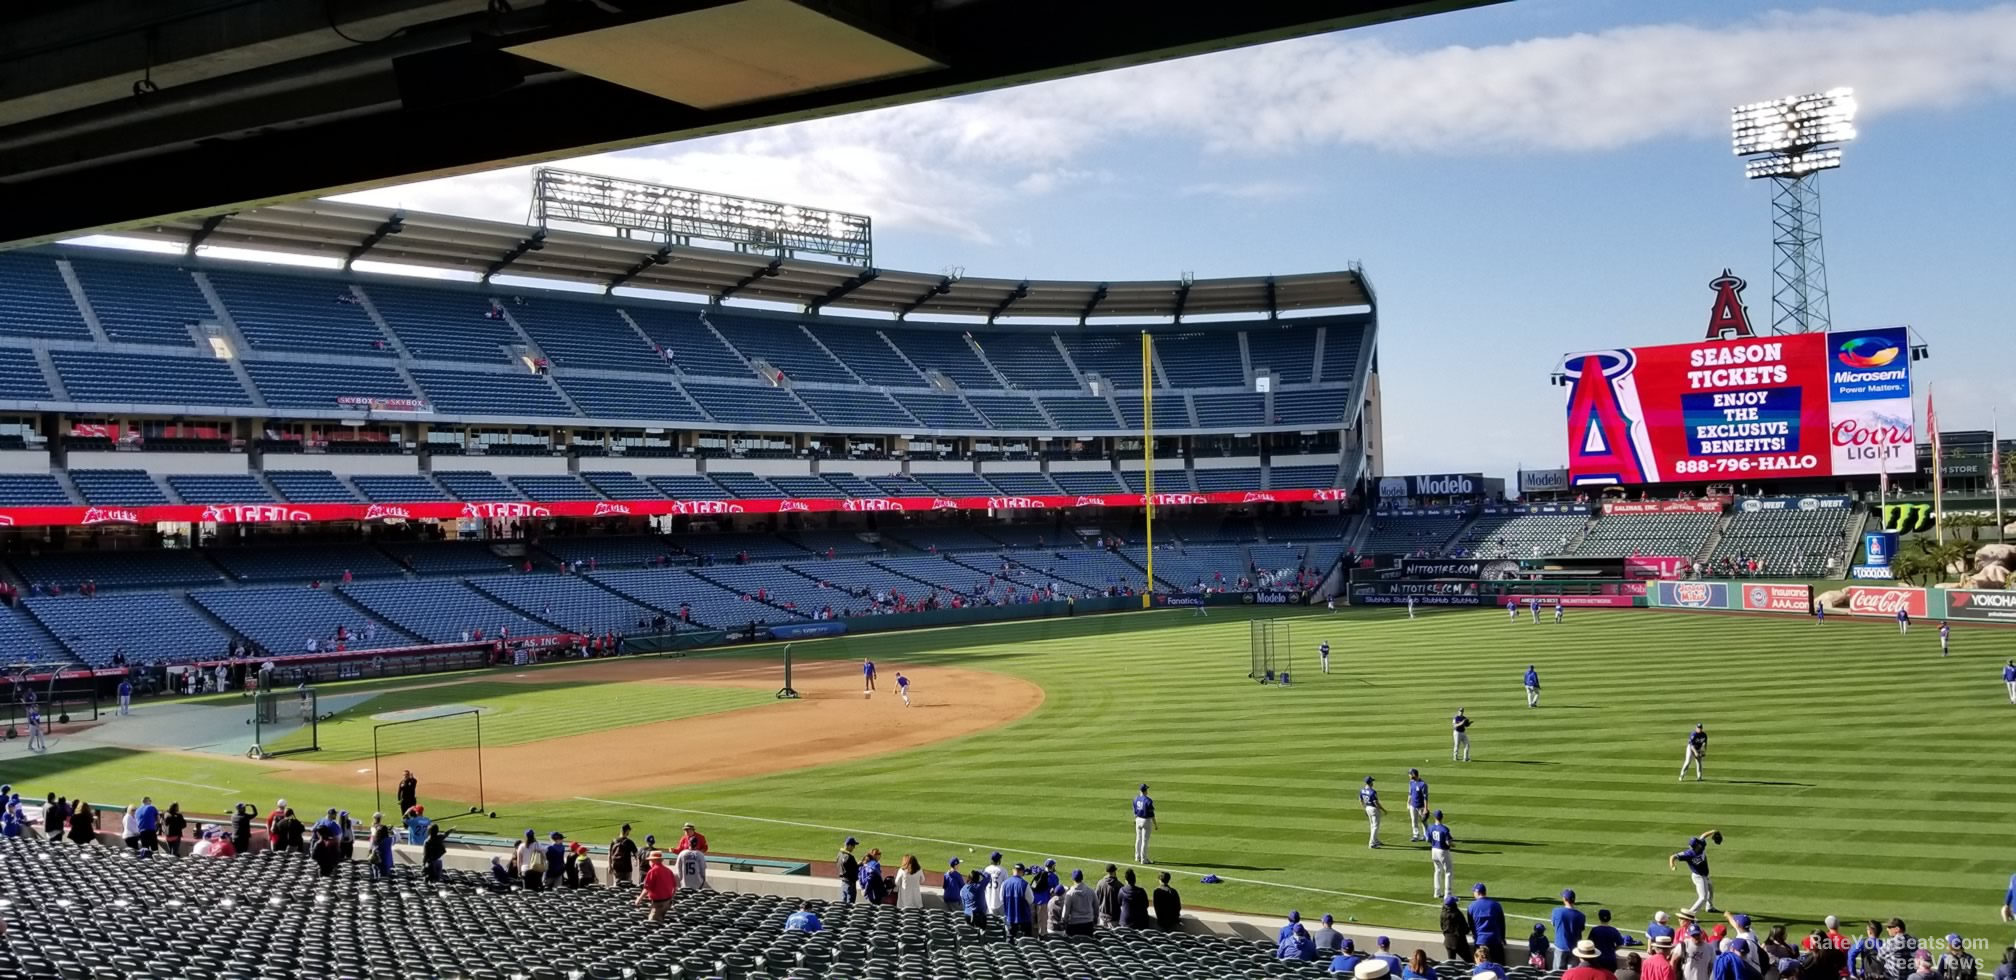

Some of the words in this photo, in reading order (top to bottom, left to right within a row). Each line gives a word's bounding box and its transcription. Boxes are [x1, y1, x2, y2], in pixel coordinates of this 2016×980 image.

[1690, 343, 1782, 368] SEASON
[1687, 365, 1788, 389] TICKETS
[1833, 368, 1906, 384] Microsemi
[1839, 386, 1866, 394] Power
[1713, 391, 1768, 407] ENJOY
[1723, 407, 1759, 421] THE
[1697, 421, 1789, 439] EXCLUSIVE
[1832, 419, 1913, 447] Coors
[1700, 437, 1786, 454] BENEFITS!
[1847, 445, 1902, 460] LIGHT
[1675, 455, 1817, 473] 888-796-HALO
[1949, 465, 1978, 473] STORE
[1416, 475, 1472, 494] Modelo
[1527, 473, 1562, 486] Modelo
[1763, 501, 1785, 509] WEST
[1821, 499, 1844, 508] WEST
[1407, 564, 1478, 575] NITTOTIRE.COM
[1257, 593, 1286, 603] Modelo
[1422, 596, 1448, 604] StubHub
[1451, 596, 1479, 604] StubHub
[1851, 589, 1912, 613] Coca-Cola
[541, 637, 560, 646] INC.
[685, 862, 696, 875] 15
